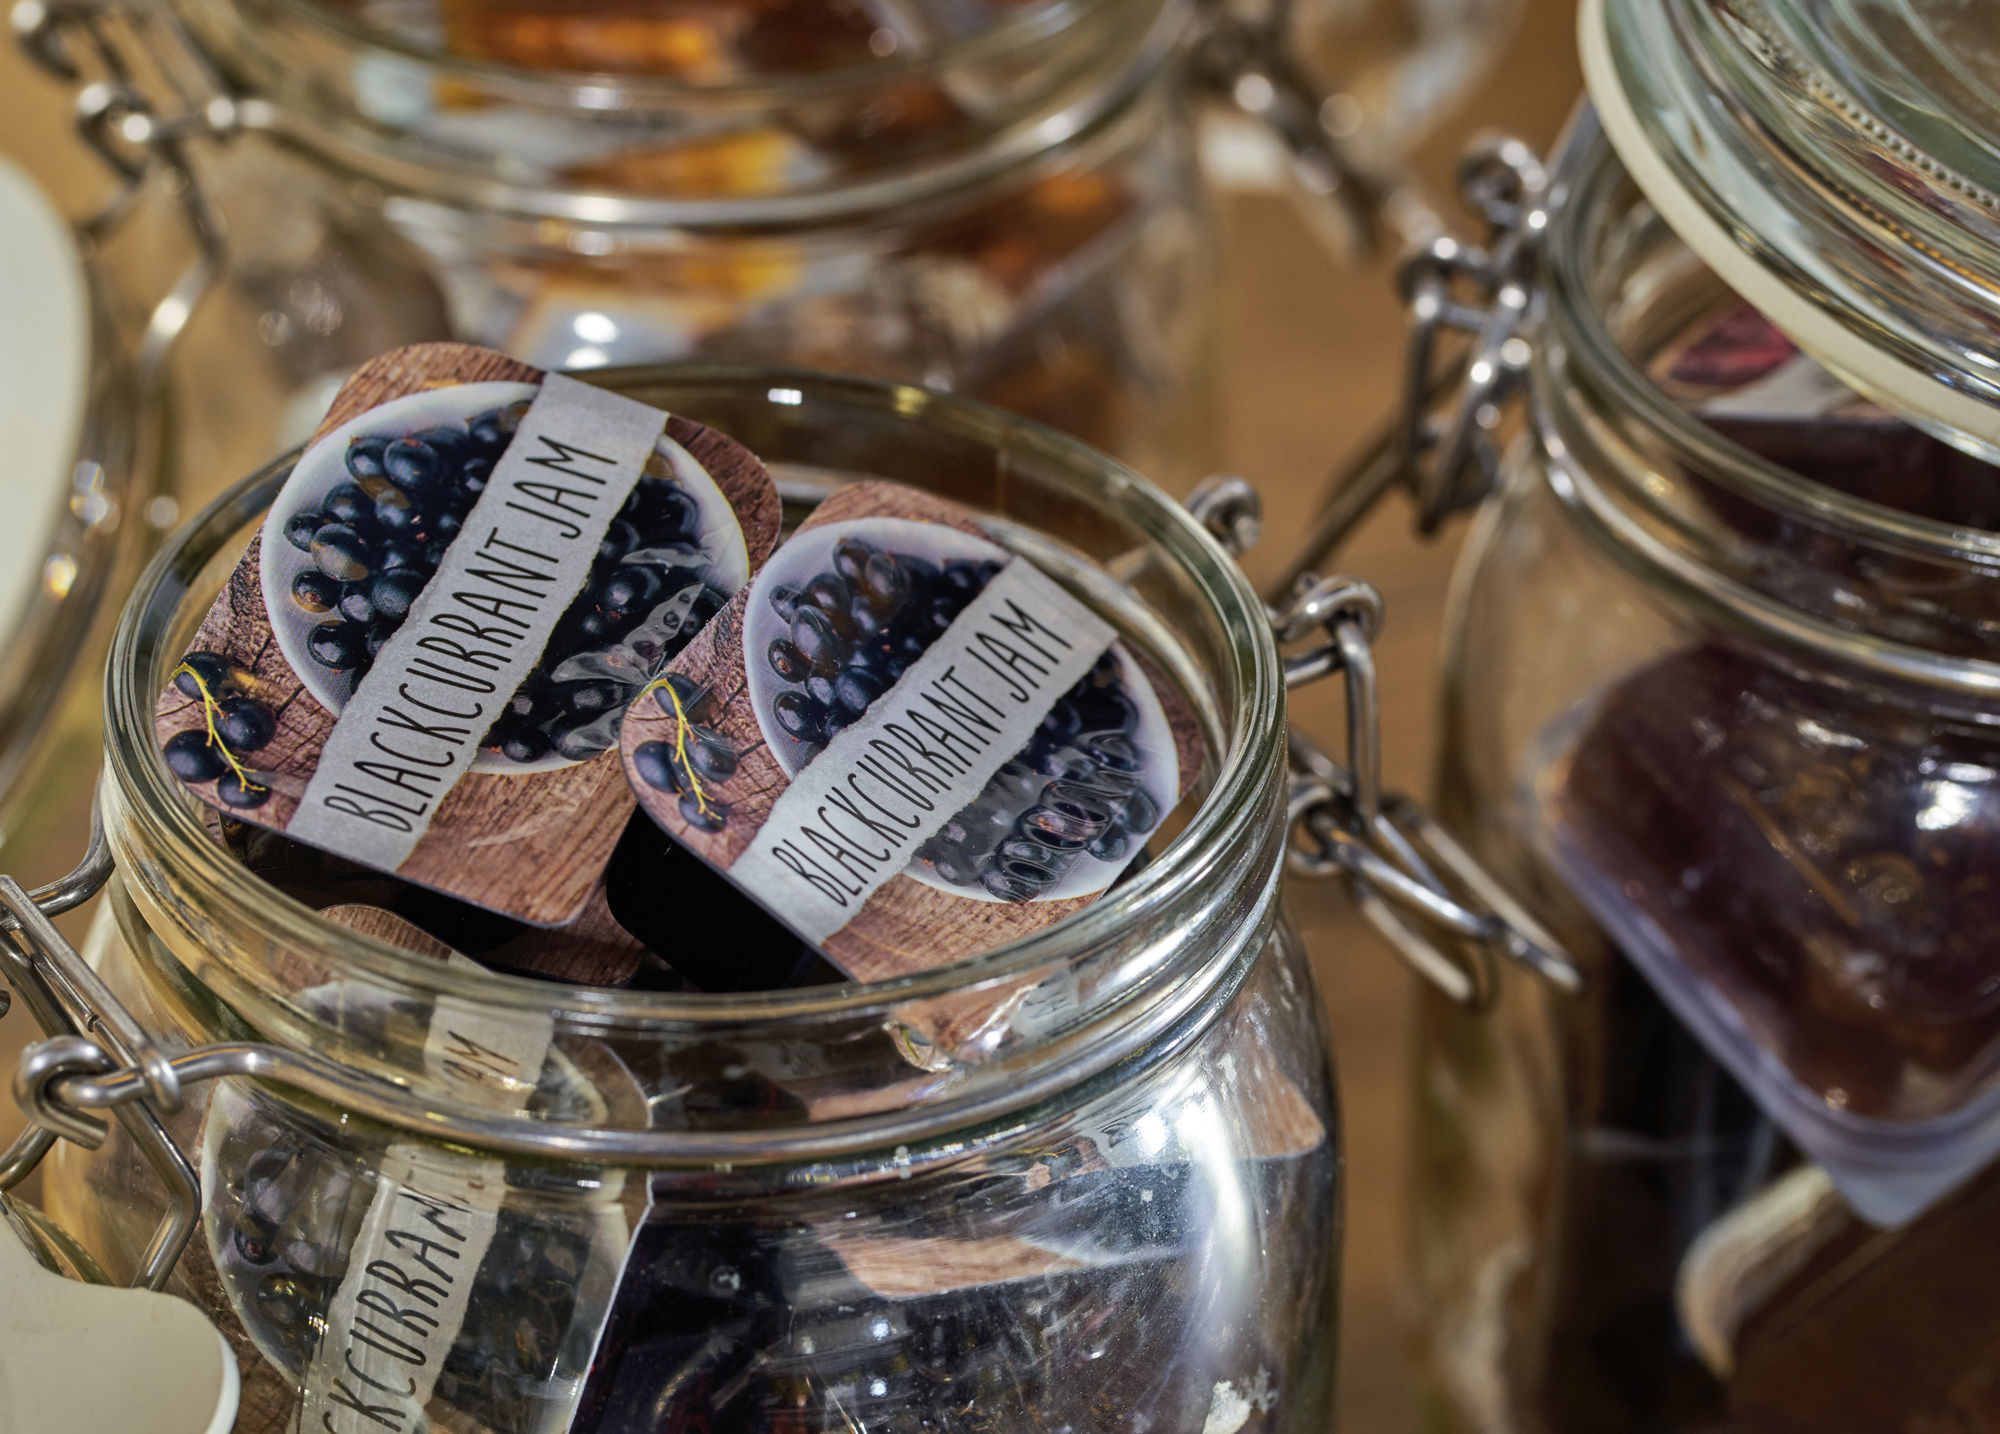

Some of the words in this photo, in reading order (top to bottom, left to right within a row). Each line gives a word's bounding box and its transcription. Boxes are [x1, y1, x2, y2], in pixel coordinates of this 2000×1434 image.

[323, 526, 560, 833] BLACKCURRANT
[505, 435, 618, 540] JAM
[771, 665, 1006, 908] BLACKCURRANT
[964, 597, 1074, 703] JAM
